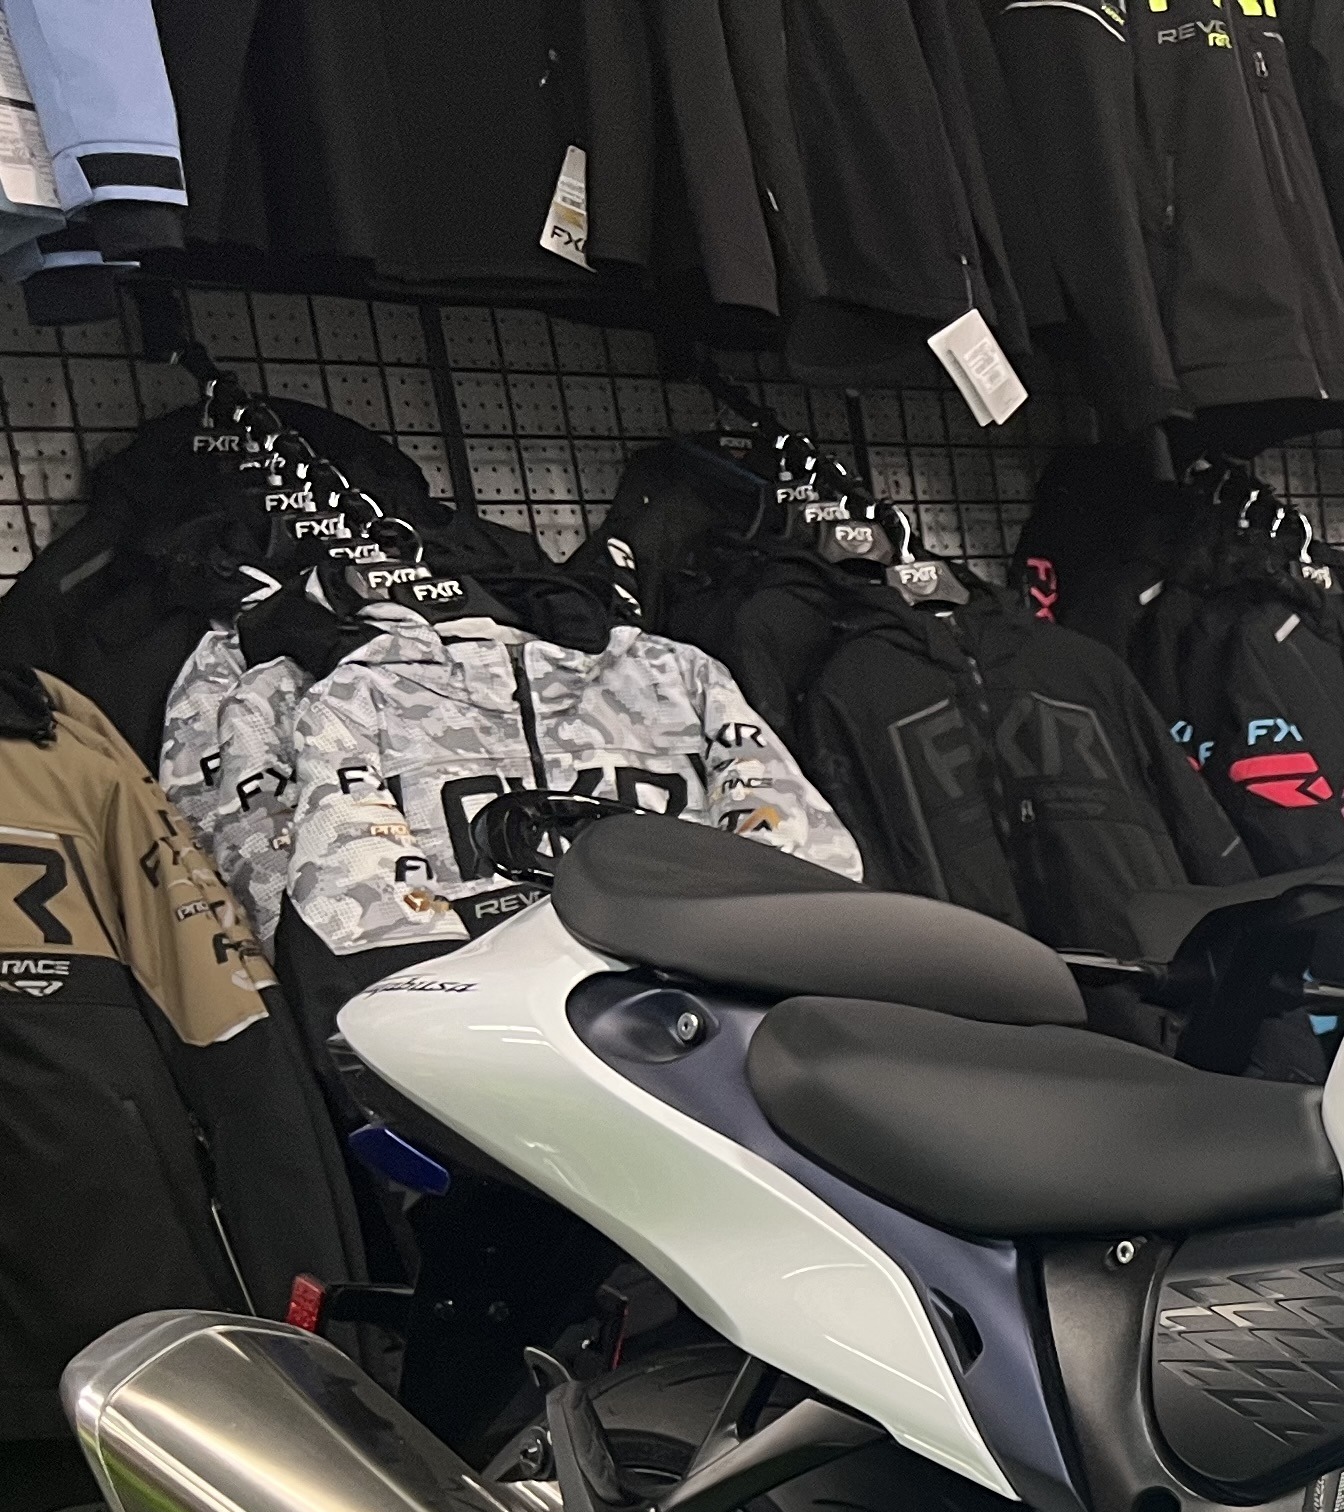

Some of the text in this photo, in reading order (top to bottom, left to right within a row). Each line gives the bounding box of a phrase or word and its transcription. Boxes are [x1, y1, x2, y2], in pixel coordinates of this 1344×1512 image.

[193, 435, 240, 452] FXR
[835, 525, 874, 542] FXR
[368, 566, 417, 590] FXR
[900, 566, 938, 584] FXR
[412, 580, 463, 602] FXR
